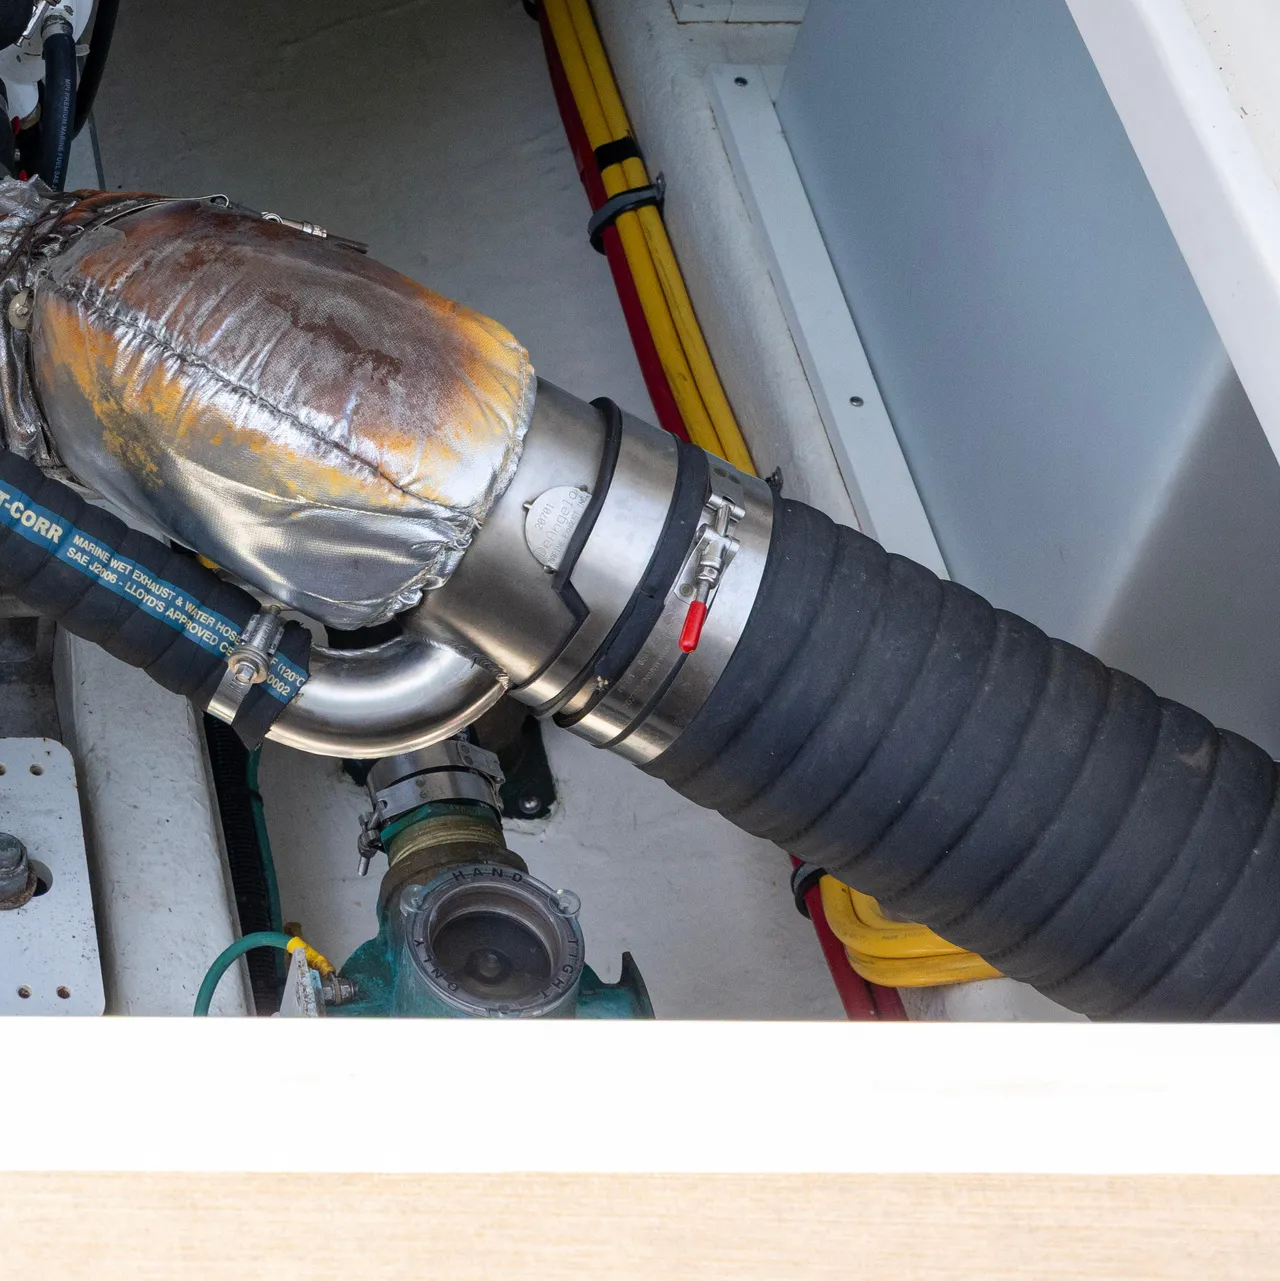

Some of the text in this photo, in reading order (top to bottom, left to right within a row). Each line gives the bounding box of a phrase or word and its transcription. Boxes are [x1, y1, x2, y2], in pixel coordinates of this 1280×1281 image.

[63, 78, 71, 91] MPI
[60, 92, 70, 125] PREMIUM
[57, 125, 67, 151] MARINE
[54, 152, 62, 169] FUEL
[65, 546, 90, 566] SAE
[87, 559, 119, 584] J2006
[123, 581, 167, 613] LLOYD'S
[164, 606, 219, 646] APPROVED
[217, 641, 235, 657] CE
[70, 533, 111, 563] MARINE
[107, 556, 133, 576] WET
[130, 569, 176, 602] EXHAUST
[173, 595, 185, 607] &
[181, 600, 216, 628] WATER
[213, 621, 243, 645] HOSE
[452, 867, 525, 884] HAND
[413, 937, 460, 993] ONLY
[540, 937, 581, 1000] TIGHT
